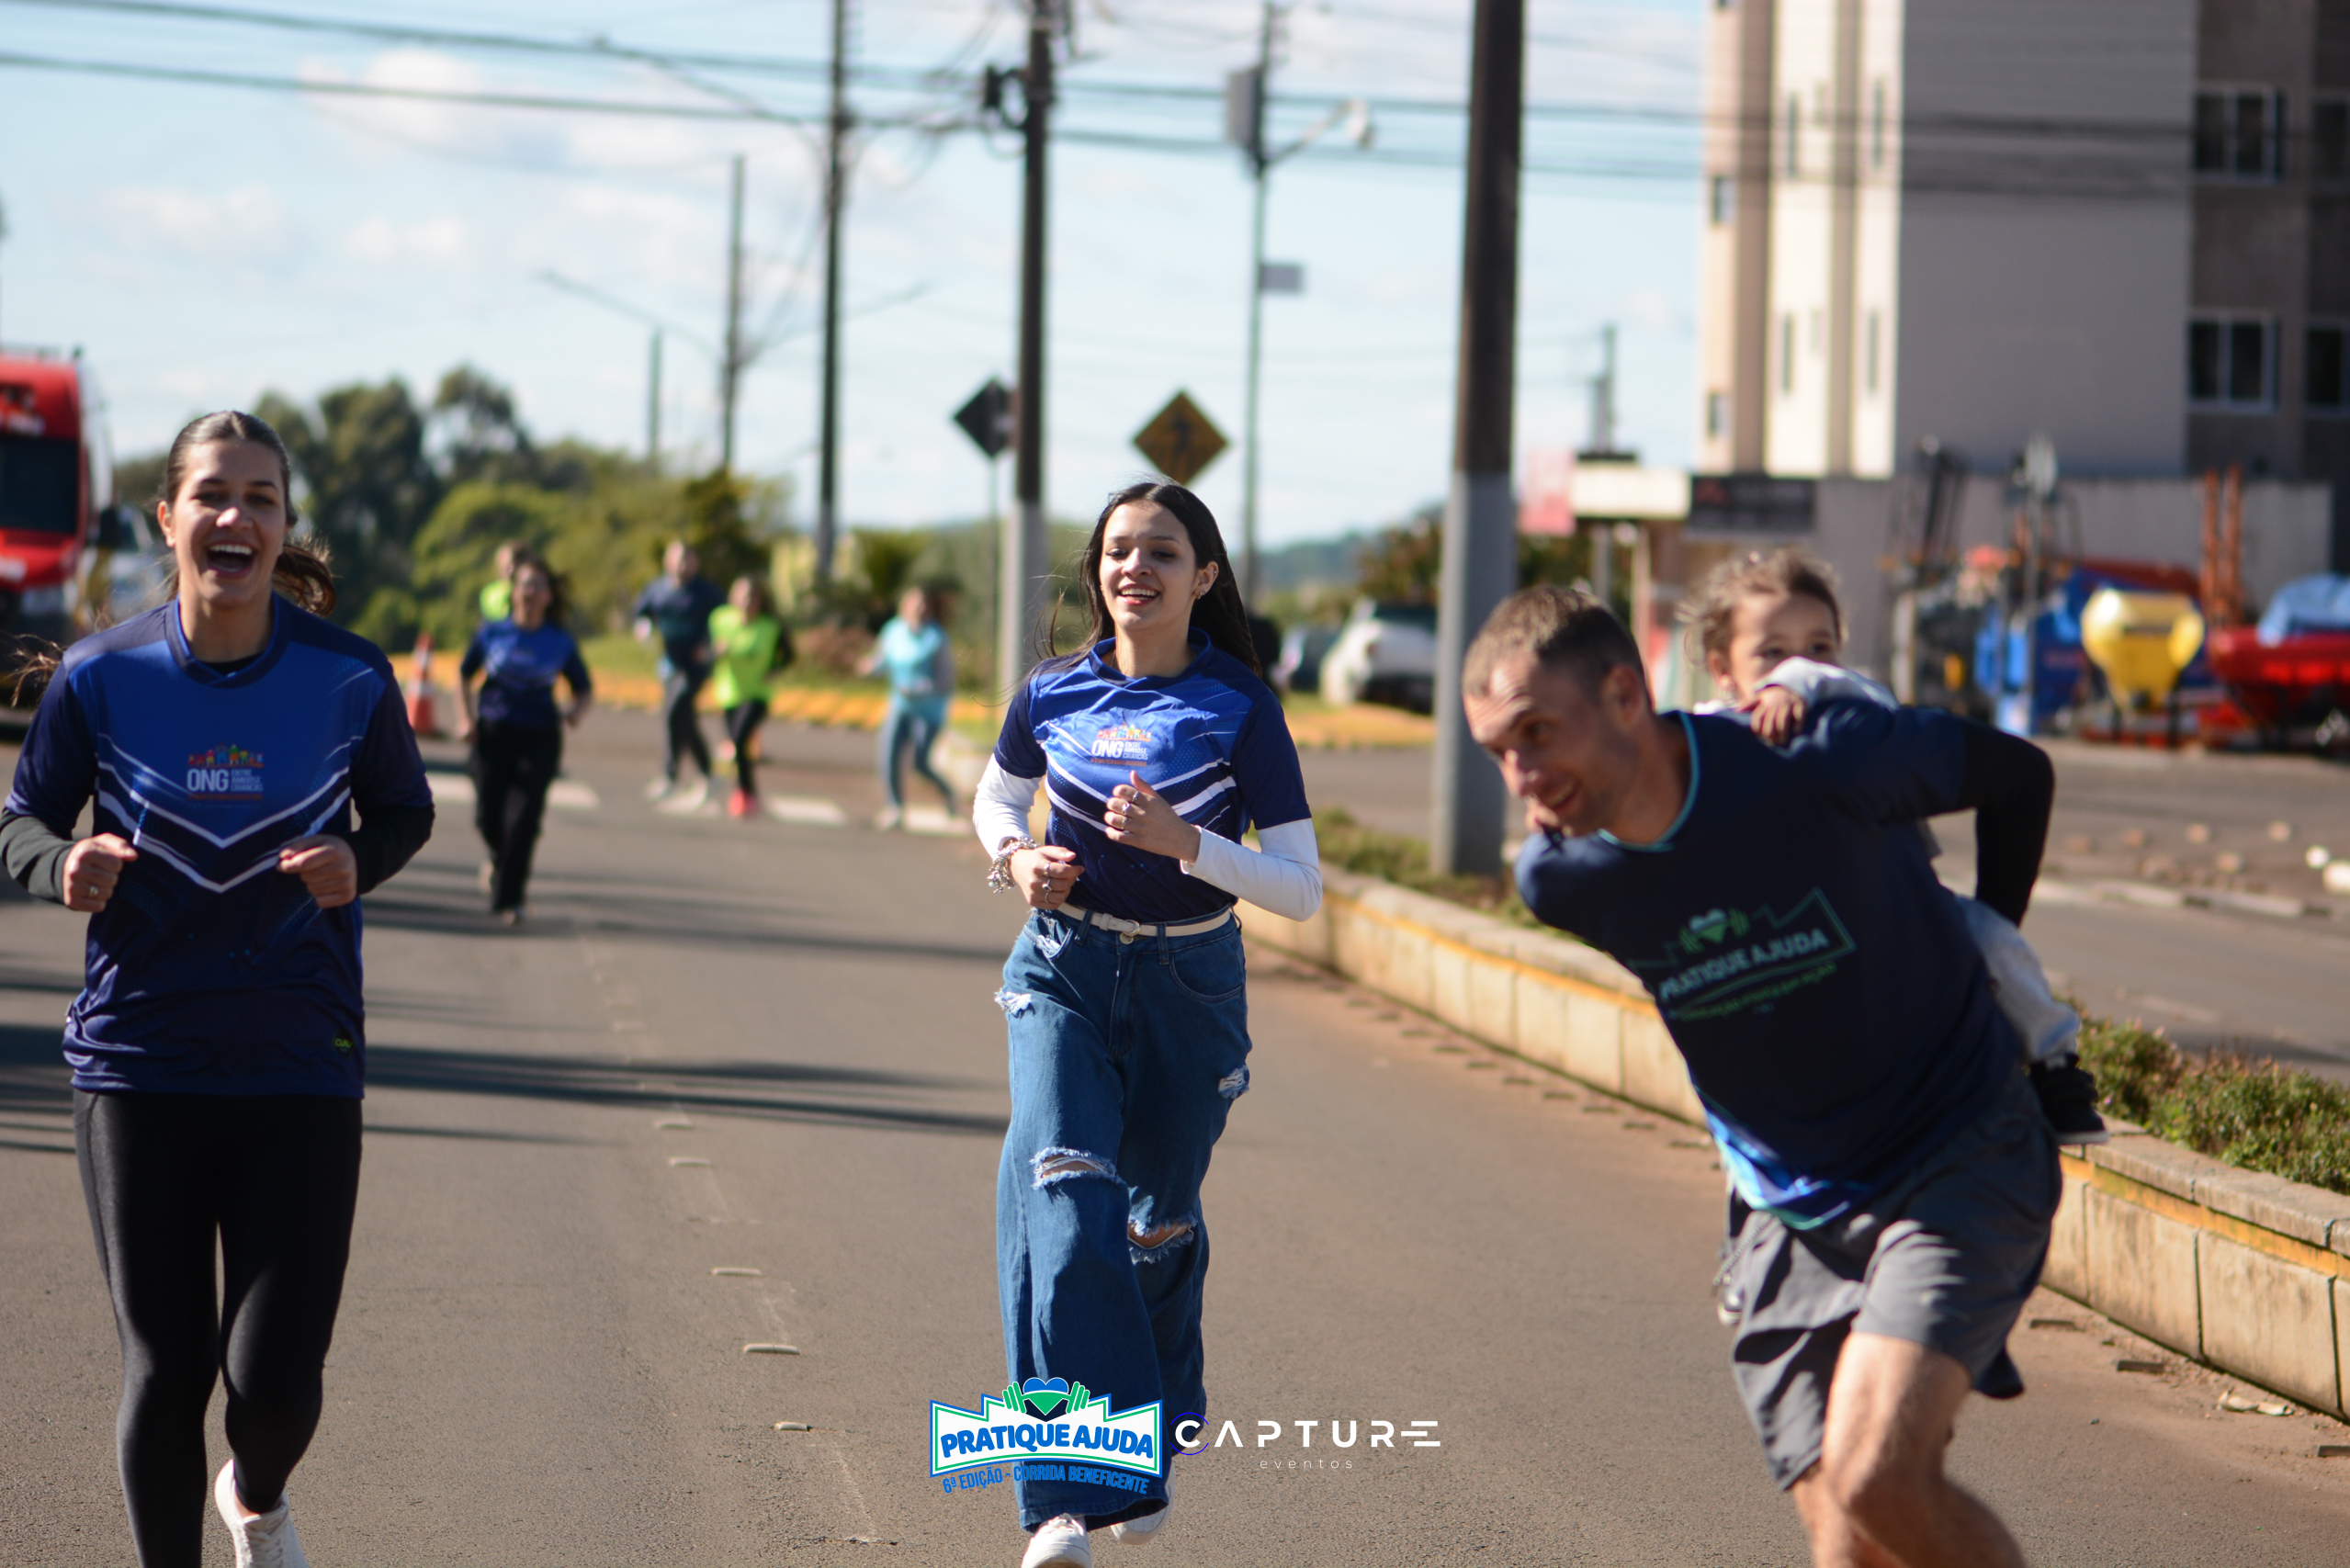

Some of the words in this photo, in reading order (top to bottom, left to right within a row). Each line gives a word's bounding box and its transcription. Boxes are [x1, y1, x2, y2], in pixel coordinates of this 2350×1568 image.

[1091, 739, 1124, 758] ONG
[187, 768, 229, 792] ONG
[1751, 927, 1830, 965] AJUDA
